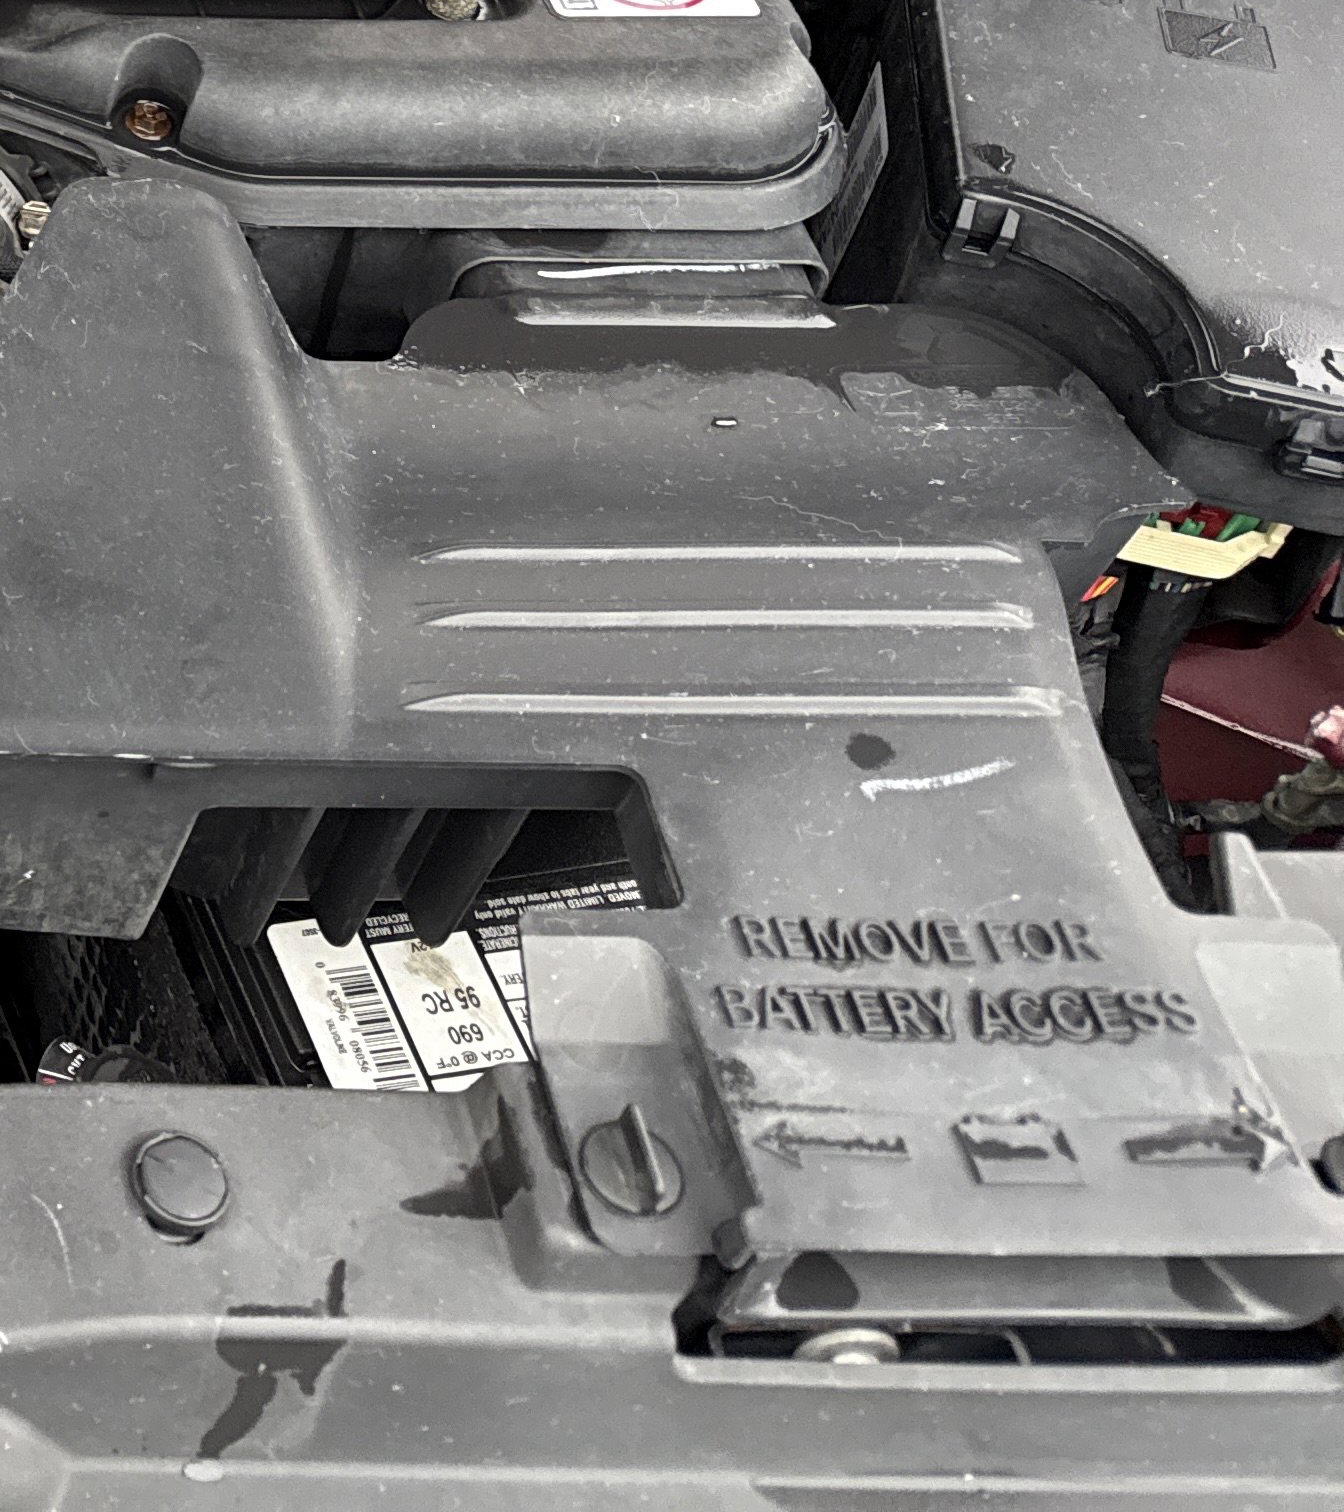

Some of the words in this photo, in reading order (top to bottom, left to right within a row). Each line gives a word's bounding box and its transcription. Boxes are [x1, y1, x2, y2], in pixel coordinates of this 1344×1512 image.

[365, 912, 410, 928] RECYCLED
[365, 925, 391, 939] MUST
[731, 915, 976, 968] REMOVE
[978, 917, 1104, 966] FOR
[421, 990, 455, 1015] RC
[455, 985, 481, 1010] 95
[714, 984, 955, 1043] BATTERY
[969, 987, 1199, 1045] ACCESS
[447, 1022, 485, 1045] 690
[461, 1049, 479, 1064] @
[483, 1047, 516, 1061] CCA
